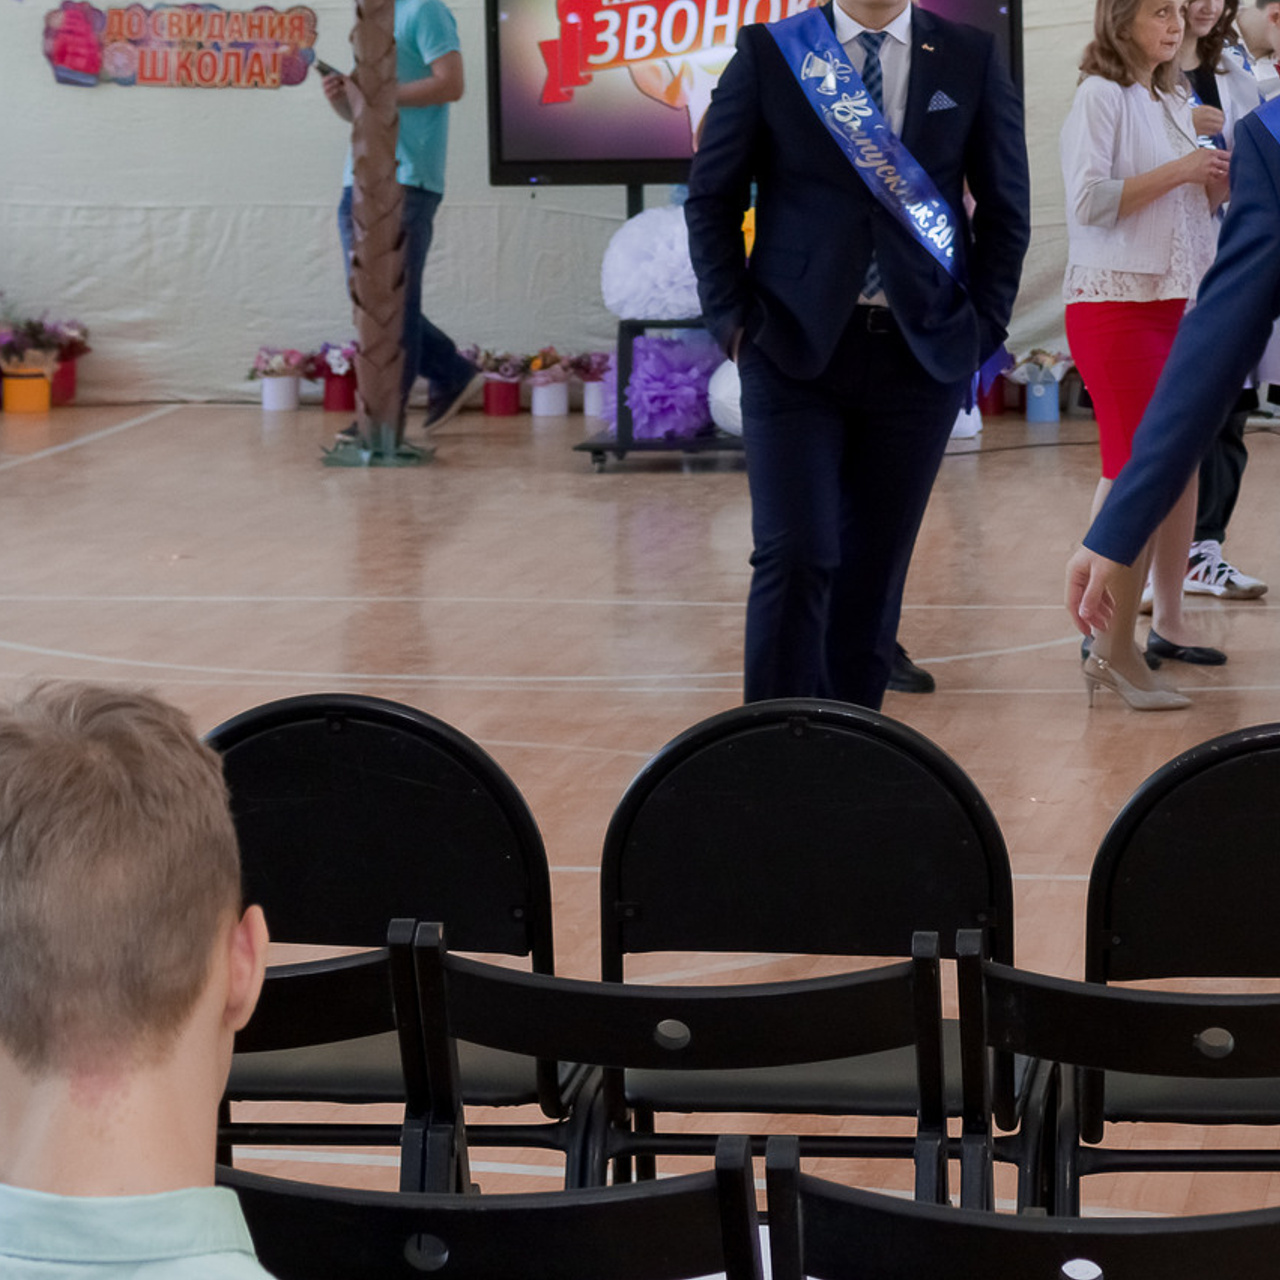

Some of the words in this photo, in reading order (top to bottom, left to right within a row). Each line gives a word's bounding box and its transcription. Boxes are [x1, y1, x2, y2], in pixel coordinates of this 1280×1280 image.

[106, 8, 144, 41] ДО
[153, 10, 305, 42] СВИДАНИЯ
[137, 49, 280, 85] ШКОЛА!
